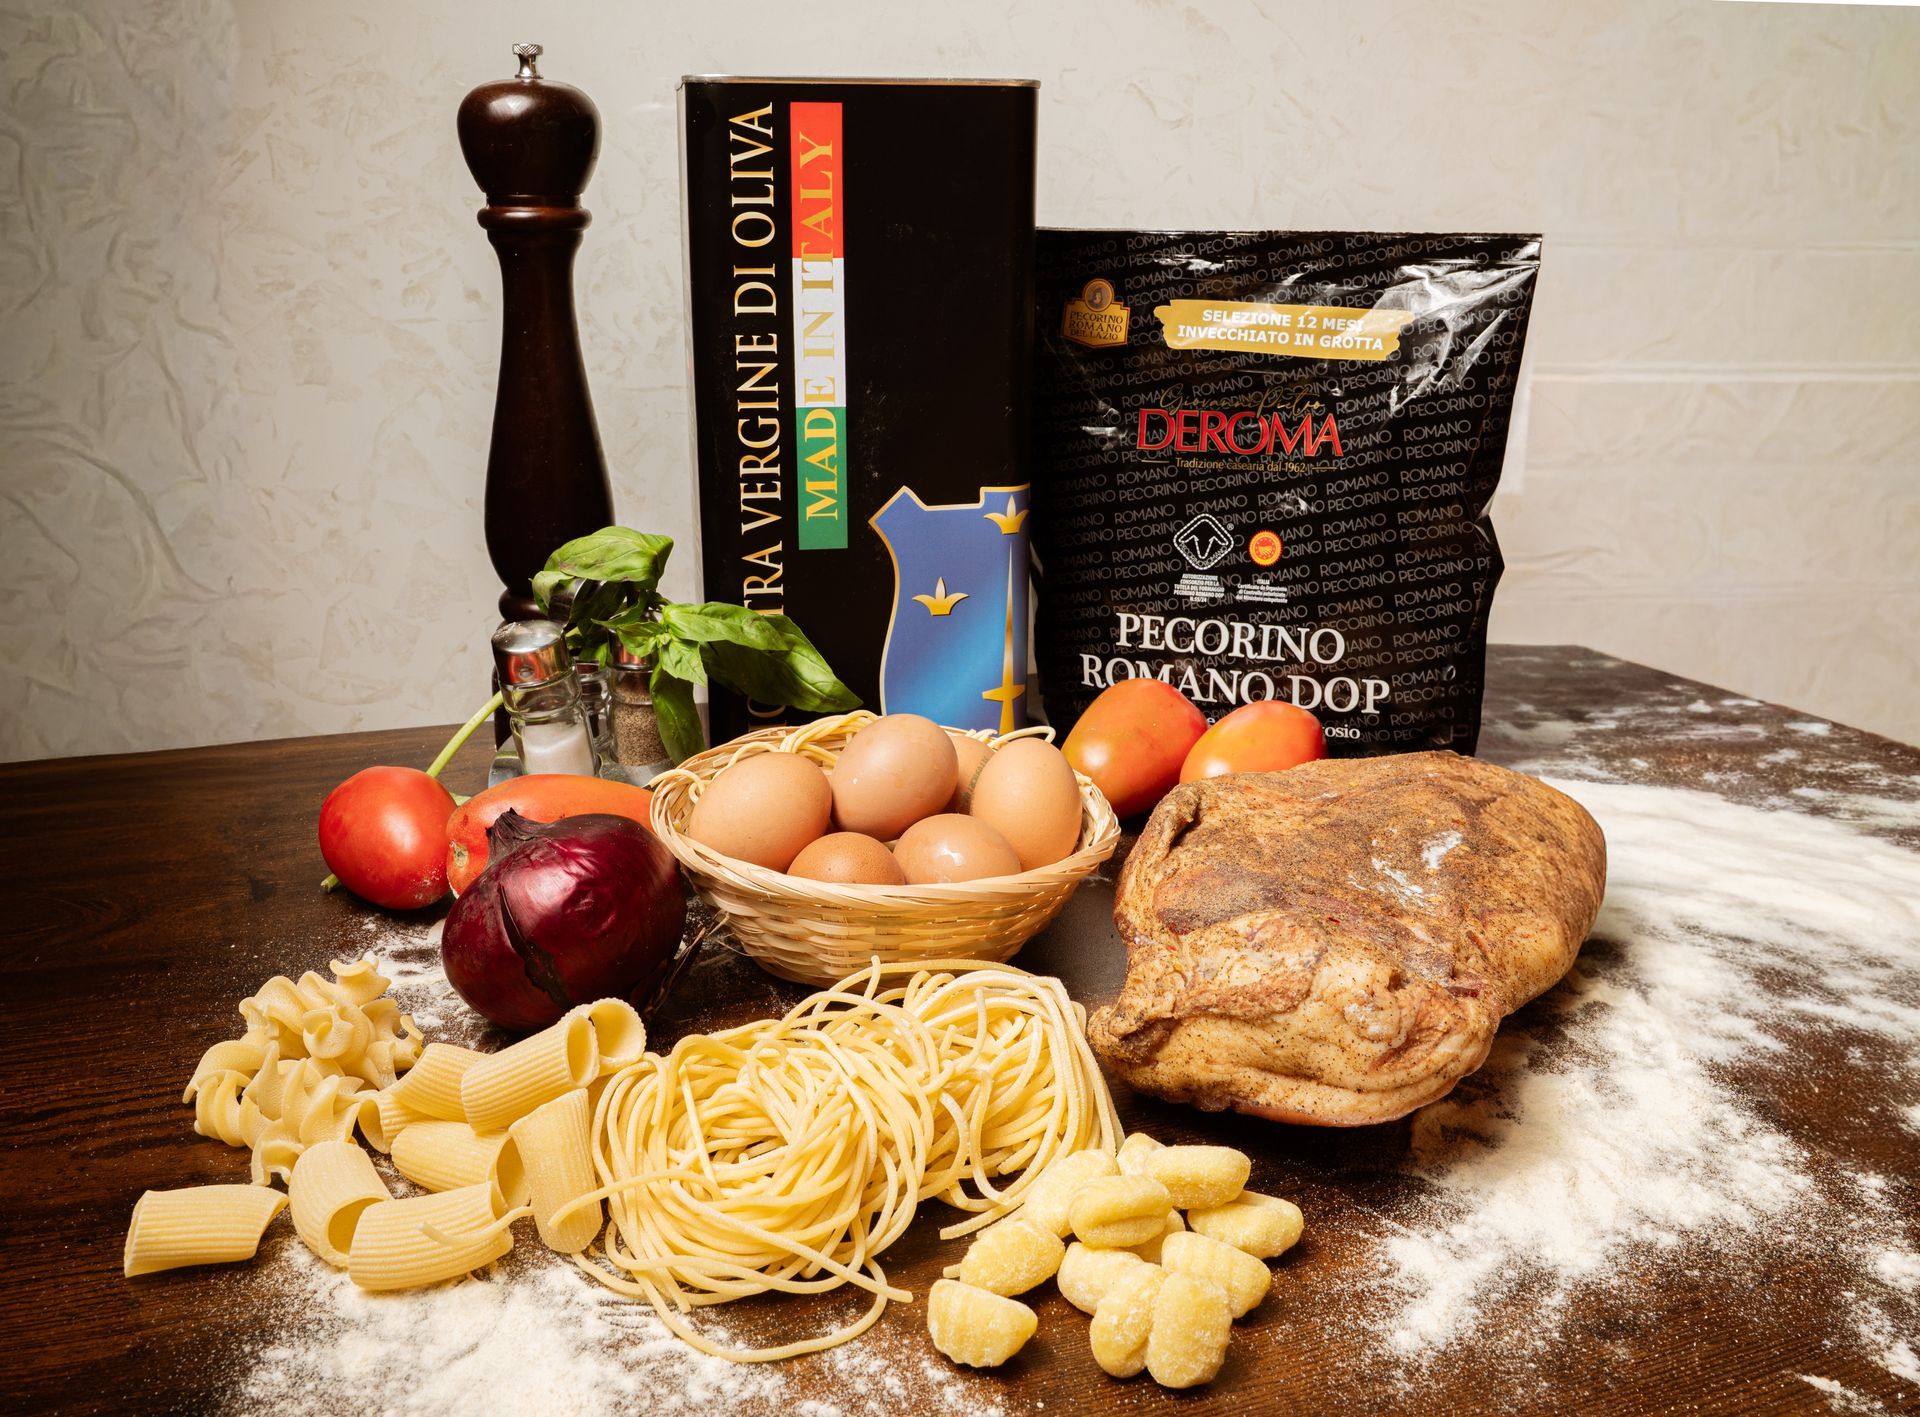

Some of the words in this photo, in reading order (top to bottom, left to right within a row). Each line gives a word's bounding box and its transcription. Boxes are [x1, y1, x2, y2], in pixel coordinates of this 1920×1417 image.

[729, 102, 776, 248] OLIVA
[798, 131, 834, 293] ITALY
[734, 263, 777, 316] DI
[801, 305, 835, 358] IN
[1068, 321, 1122, 333] ROMANO
[1069, 312, 1124, 324] PECORINO
[1178, 325, 1289, 344] INVECCHIATO
[1294, 333, 1314, 346] IN
[1319, 336, 1384, 351] GROTTA
[1202, 309, 1292, 327] SELEZIONE
[1297, 316, 1317, 329] 12
[1322, 318, 1364, 332] MESI
[736, 333, 781, 535] VERGINE
[803, 375, 838, 522] MADE
[1136, 408, 1344, 456] DEROMA
[1119, 481, 1188, 502] PECORINO
[1191, 471, 1260, 493] PECORINO
[1175, 457, 1225, 470] Tradizione
[1226, 462, 1264, 472] casearia
[1267, 461, 1282, 472] dal
[1284, 462, 1306, 473] 1962
[1114, 504, 1175, 524] ROMANO
[1186, 495, 1248, 516] ROMANO
[1326, 472, 1389, 495] ROMANO
[1400, 462, 1466, 484] ROMANO
[1328, 488, 1399, 512] PECORINO
[1112, 543, 1172, 563] ROMANO
[1323, 513, 1387, 536] ROMANO
[1397, 504, 1463, 524] ROMANO
[1115, 559, 1182, 580] PECORINO
[1325, 529, 1396, 552] PECORINO
[1400, 521, 1474, 542] PECORINO
[741, 540, 784, 615] TRA
[1110, 582, 1169, 600] ROMANO
[1320, 554, 1384, 577] ROMANO
[1395, 544, 1462, 566] ROMANO
[1323, 571, 1395, 594] PECORINO
[1398, 558, 1473, 583] PECORINO
[1318, 595, 1383, 617] ROMANO
[1394, 583, 1461, 607] ROMANO
[1398, 599, 1472, 624] PECORINO
[1115, 612, 1346, 665] PECORINO
[1393, 624, 1460, 648] ROMANO
[1079, 653, 1275, 705] ROMANO
[1287, 674, 1390, 714] DOP
